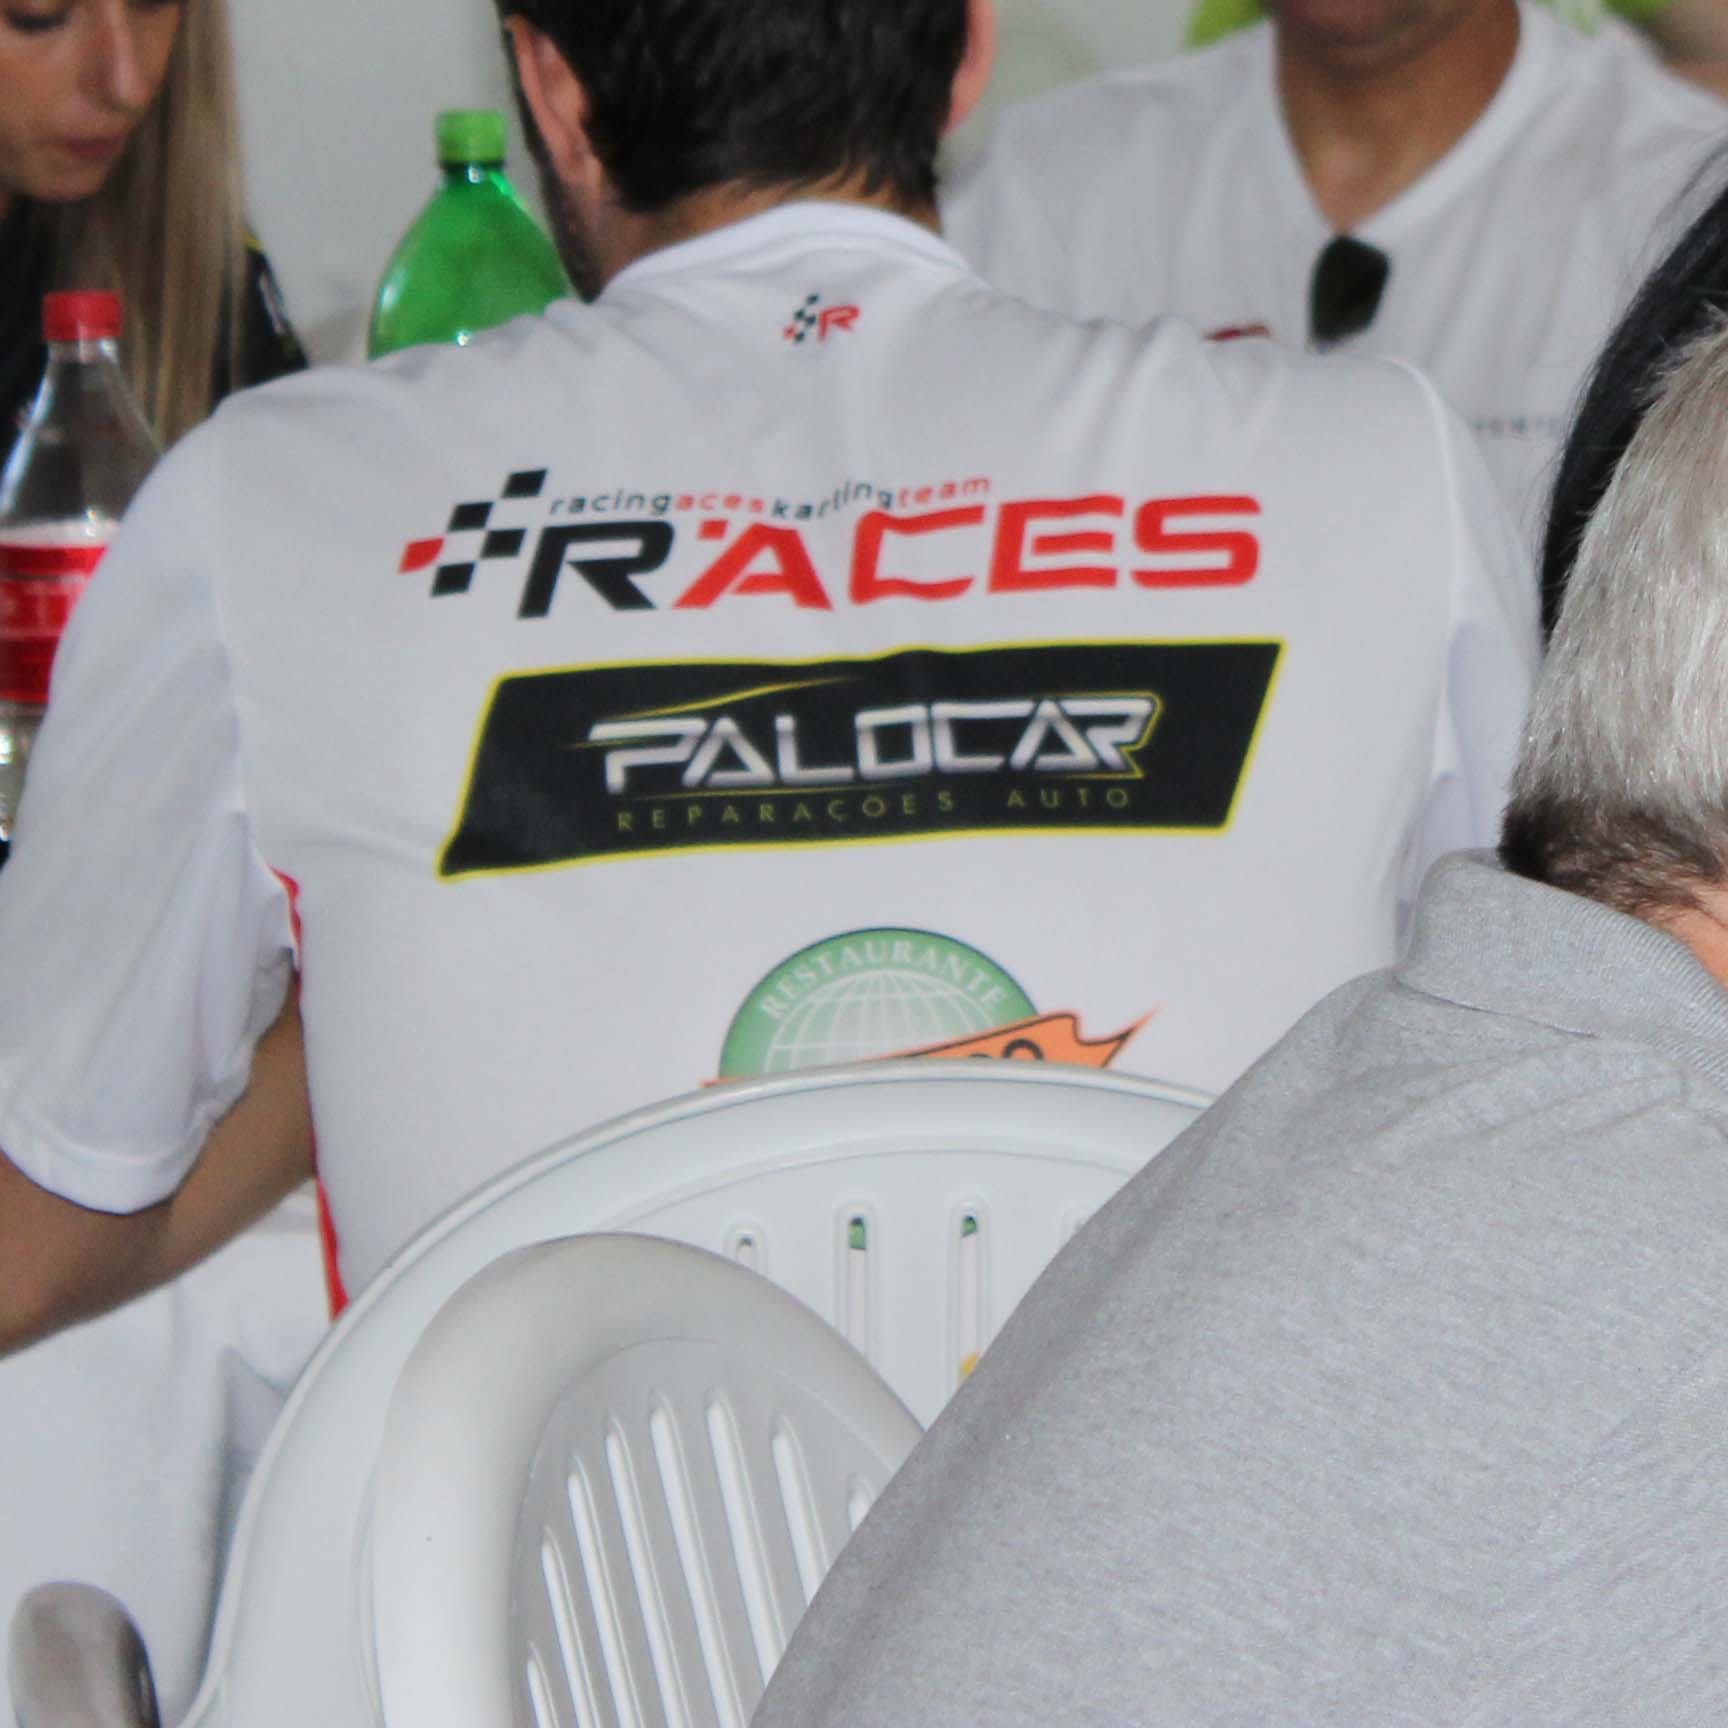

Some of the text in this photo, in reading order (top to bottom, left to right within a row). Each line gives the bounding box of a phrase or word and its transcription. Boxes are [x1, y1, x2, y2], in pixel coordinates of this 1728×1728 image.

[588, 700, 1143, 794] PALOCAR
[1007, 787, 1128, 809] AUTO
[759, 940, 1008, 1022] RESTAURANTE
